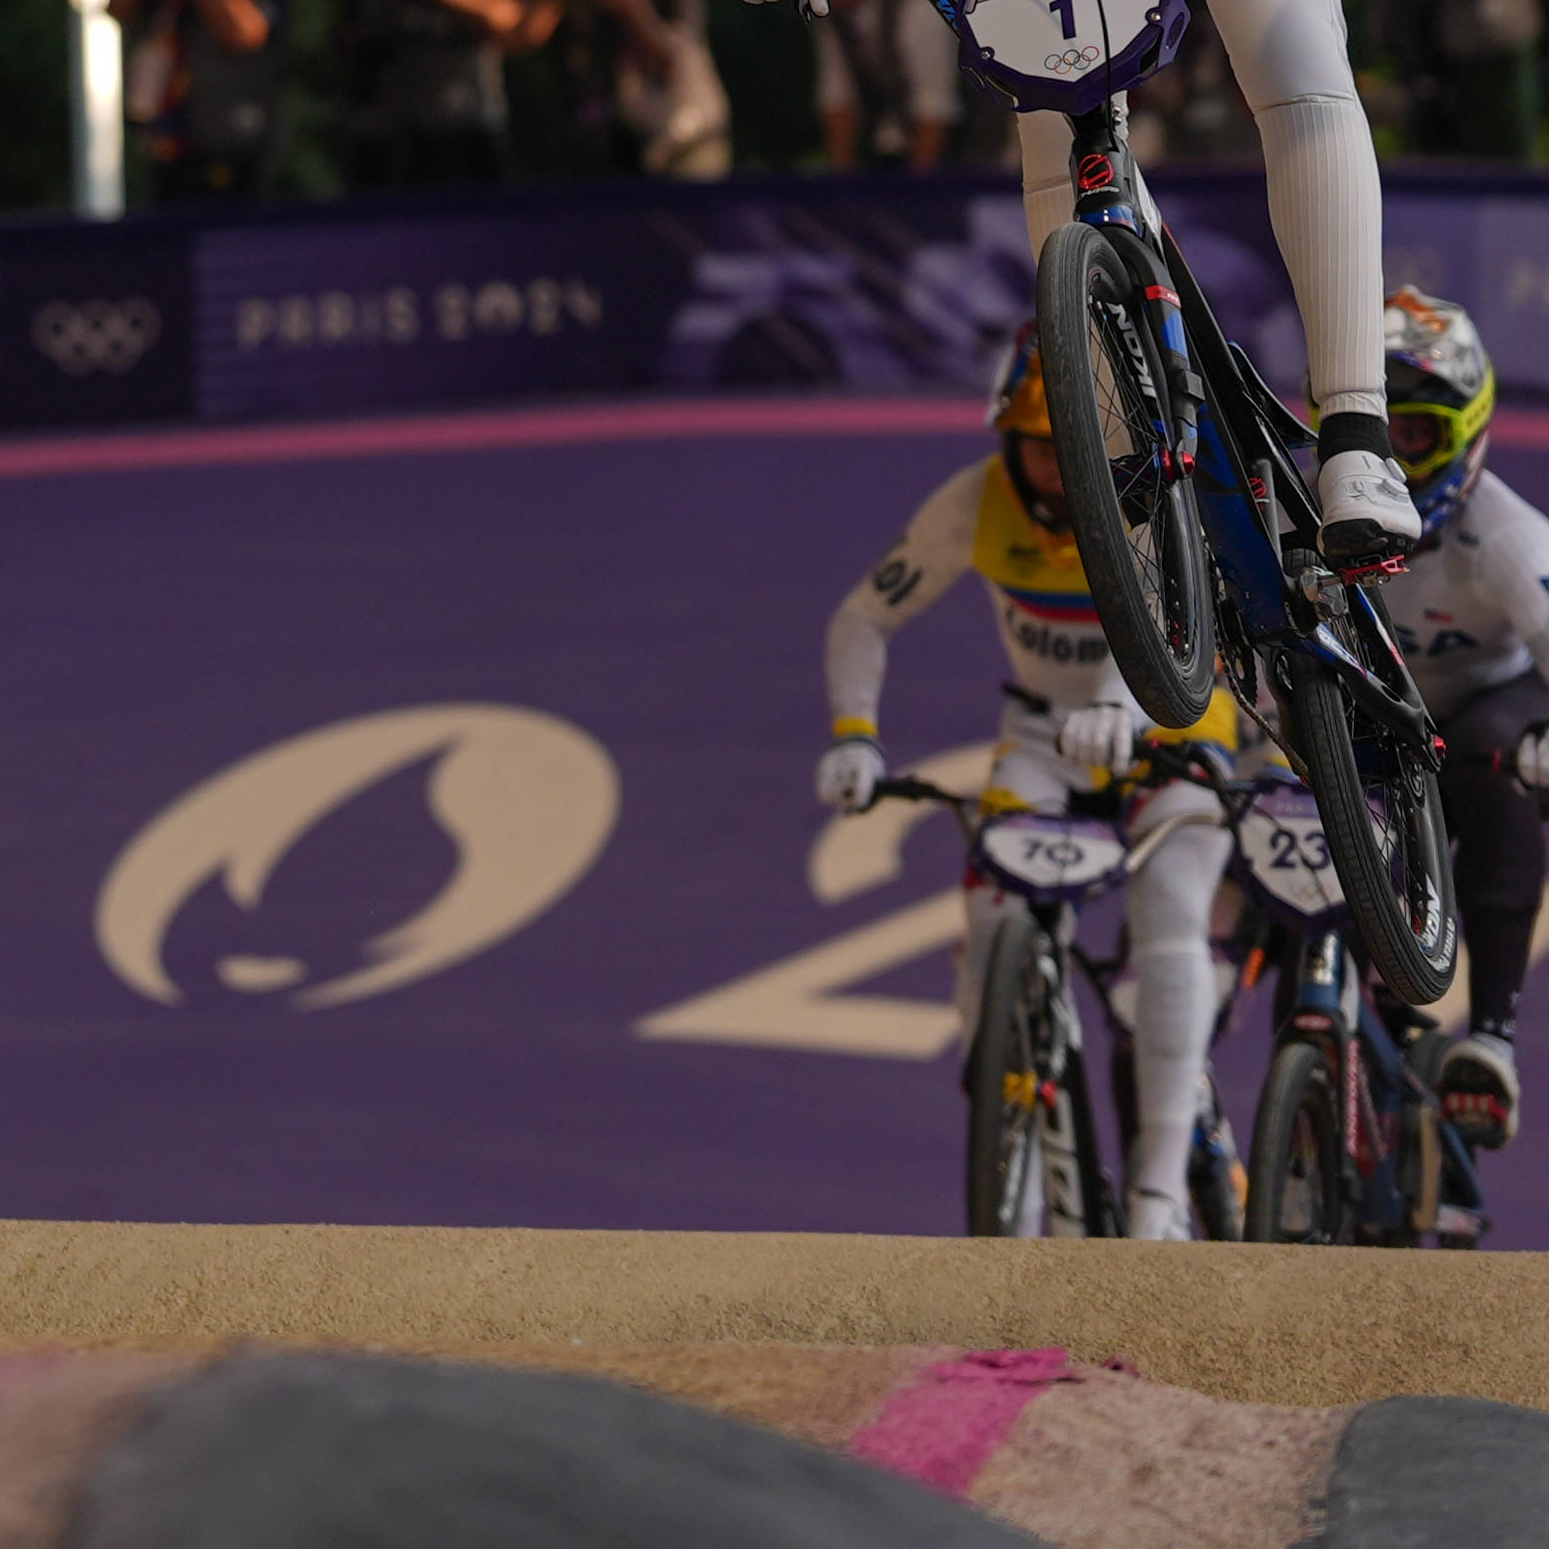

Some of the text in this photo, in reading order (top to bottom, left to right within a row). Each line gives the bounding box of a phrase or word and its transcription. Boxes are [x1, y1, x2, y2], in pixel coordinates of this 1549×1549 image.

[236, 286, 420, 349] PARIS
[1024, 837, 1084, 868] 70
[1269, 828, 1332, 872] 23
